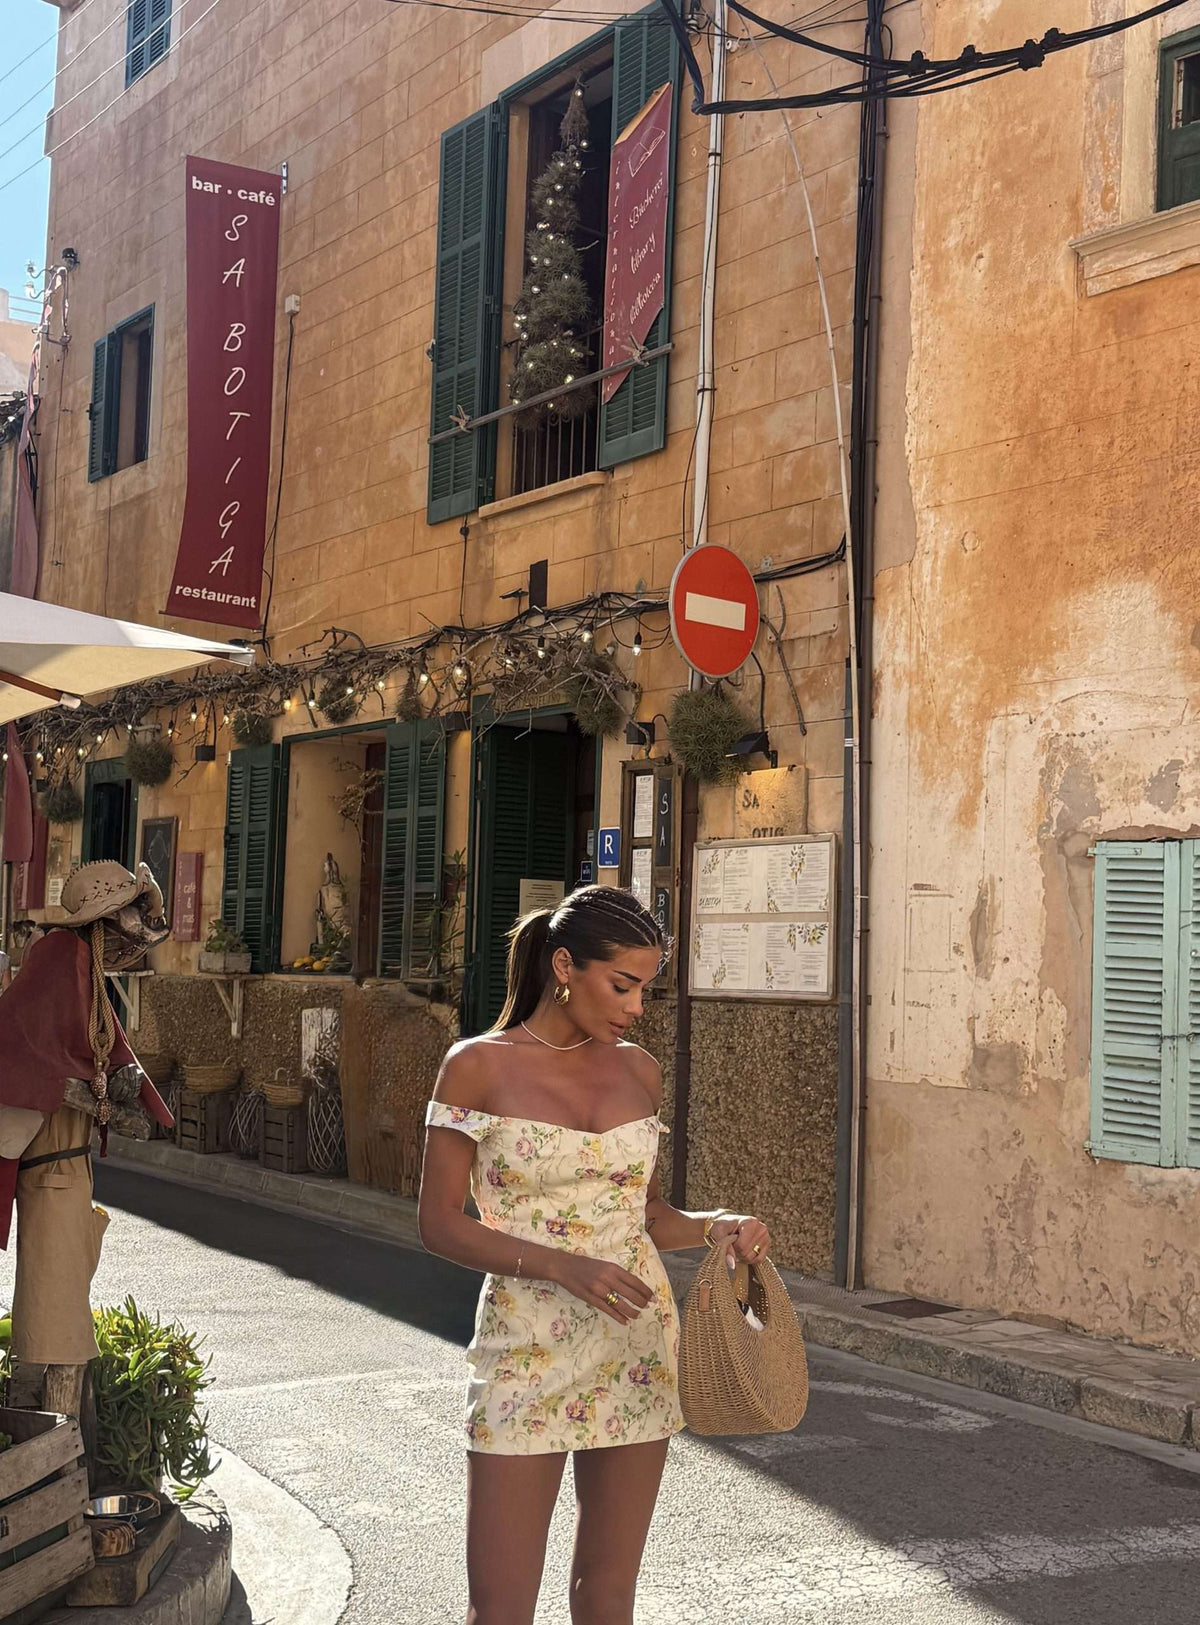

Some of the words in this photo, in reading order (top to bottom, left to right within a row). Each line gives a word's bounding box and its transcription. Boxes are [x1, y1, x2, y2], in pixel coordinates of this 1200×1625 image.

[192, 176, 222, 194] bar
[237, 189, 276, 206] café
[175, 585, 257, 608] restaurant
[604, 834, 613, 855] R
